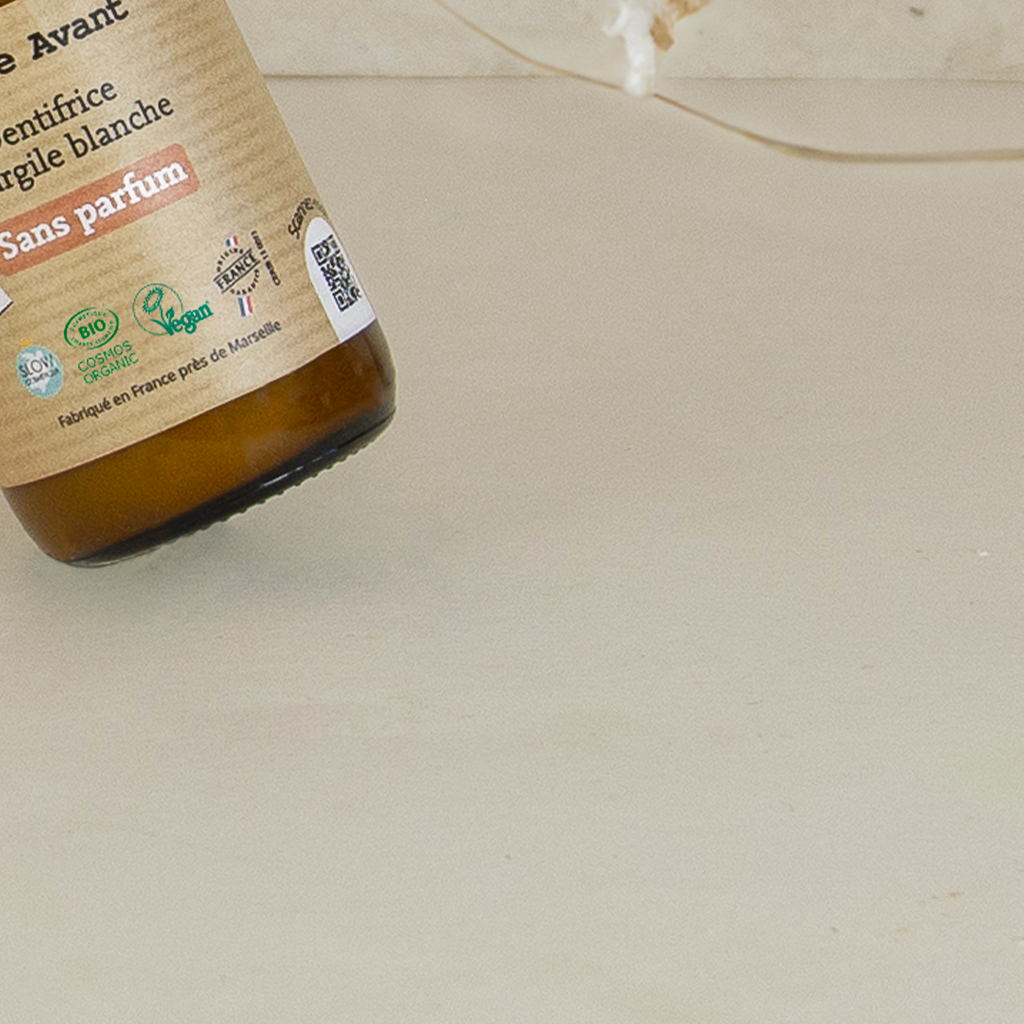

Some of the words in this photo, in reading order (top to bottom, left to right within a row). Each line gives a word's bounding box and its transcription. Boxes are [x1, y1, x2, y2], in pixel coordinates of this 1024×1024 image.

[63, 97, 174, 159] blanche
[74, 161, 189, 237] parfum
[215, 252, 258, 291] FRANCE
[78, 319, 107, 340] BIO
[154, 303, 214, 336] Vegan
[57, 398, 112, 428] Fabriqué
[112, 391, 131, 406] en
[131, 370, 177, 398] France
[178, 358, 209, 381] près
[210, 348, 228, 363] de
[227, 320, 282, 355] Marseille
[78, 340, 132, 373] COSMOS
[84, 352, 139, 385] ORGANIC
